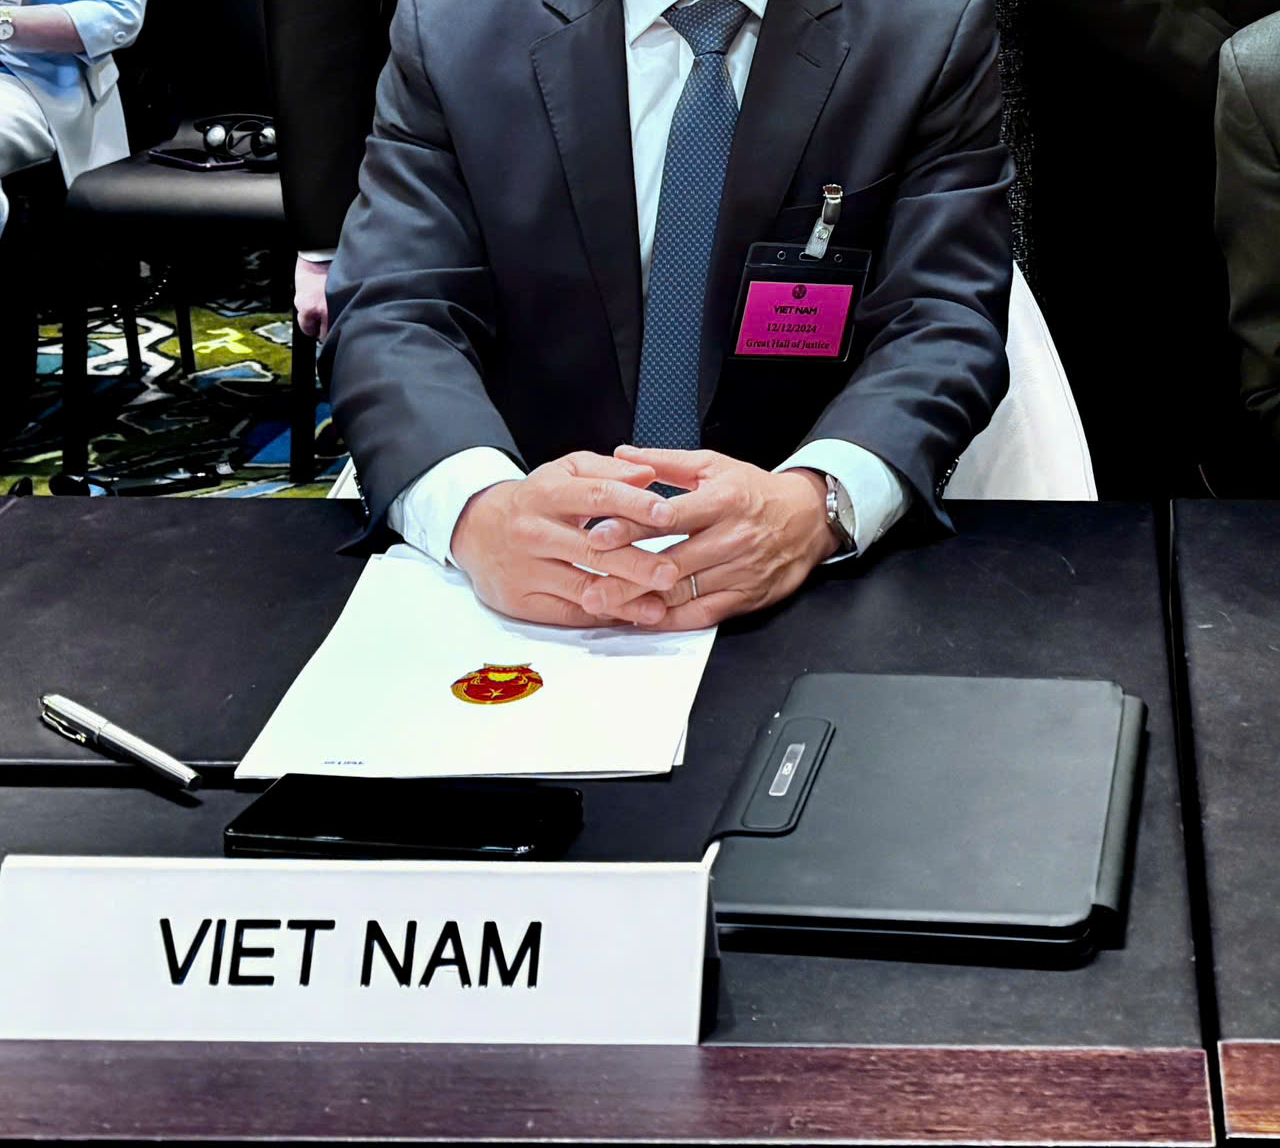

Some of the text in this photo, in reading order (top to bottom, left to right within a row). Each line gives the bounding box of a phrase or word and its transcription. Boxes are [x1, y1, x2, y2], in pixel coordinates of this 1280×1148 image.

[773, 305, 818, 315] VIET NAM
[767, 323, 817, 333] 12/12/2024
[746, 339, 830, 349] Great Hall of Justice
[160, 918, 542, 988] VIET NAM
